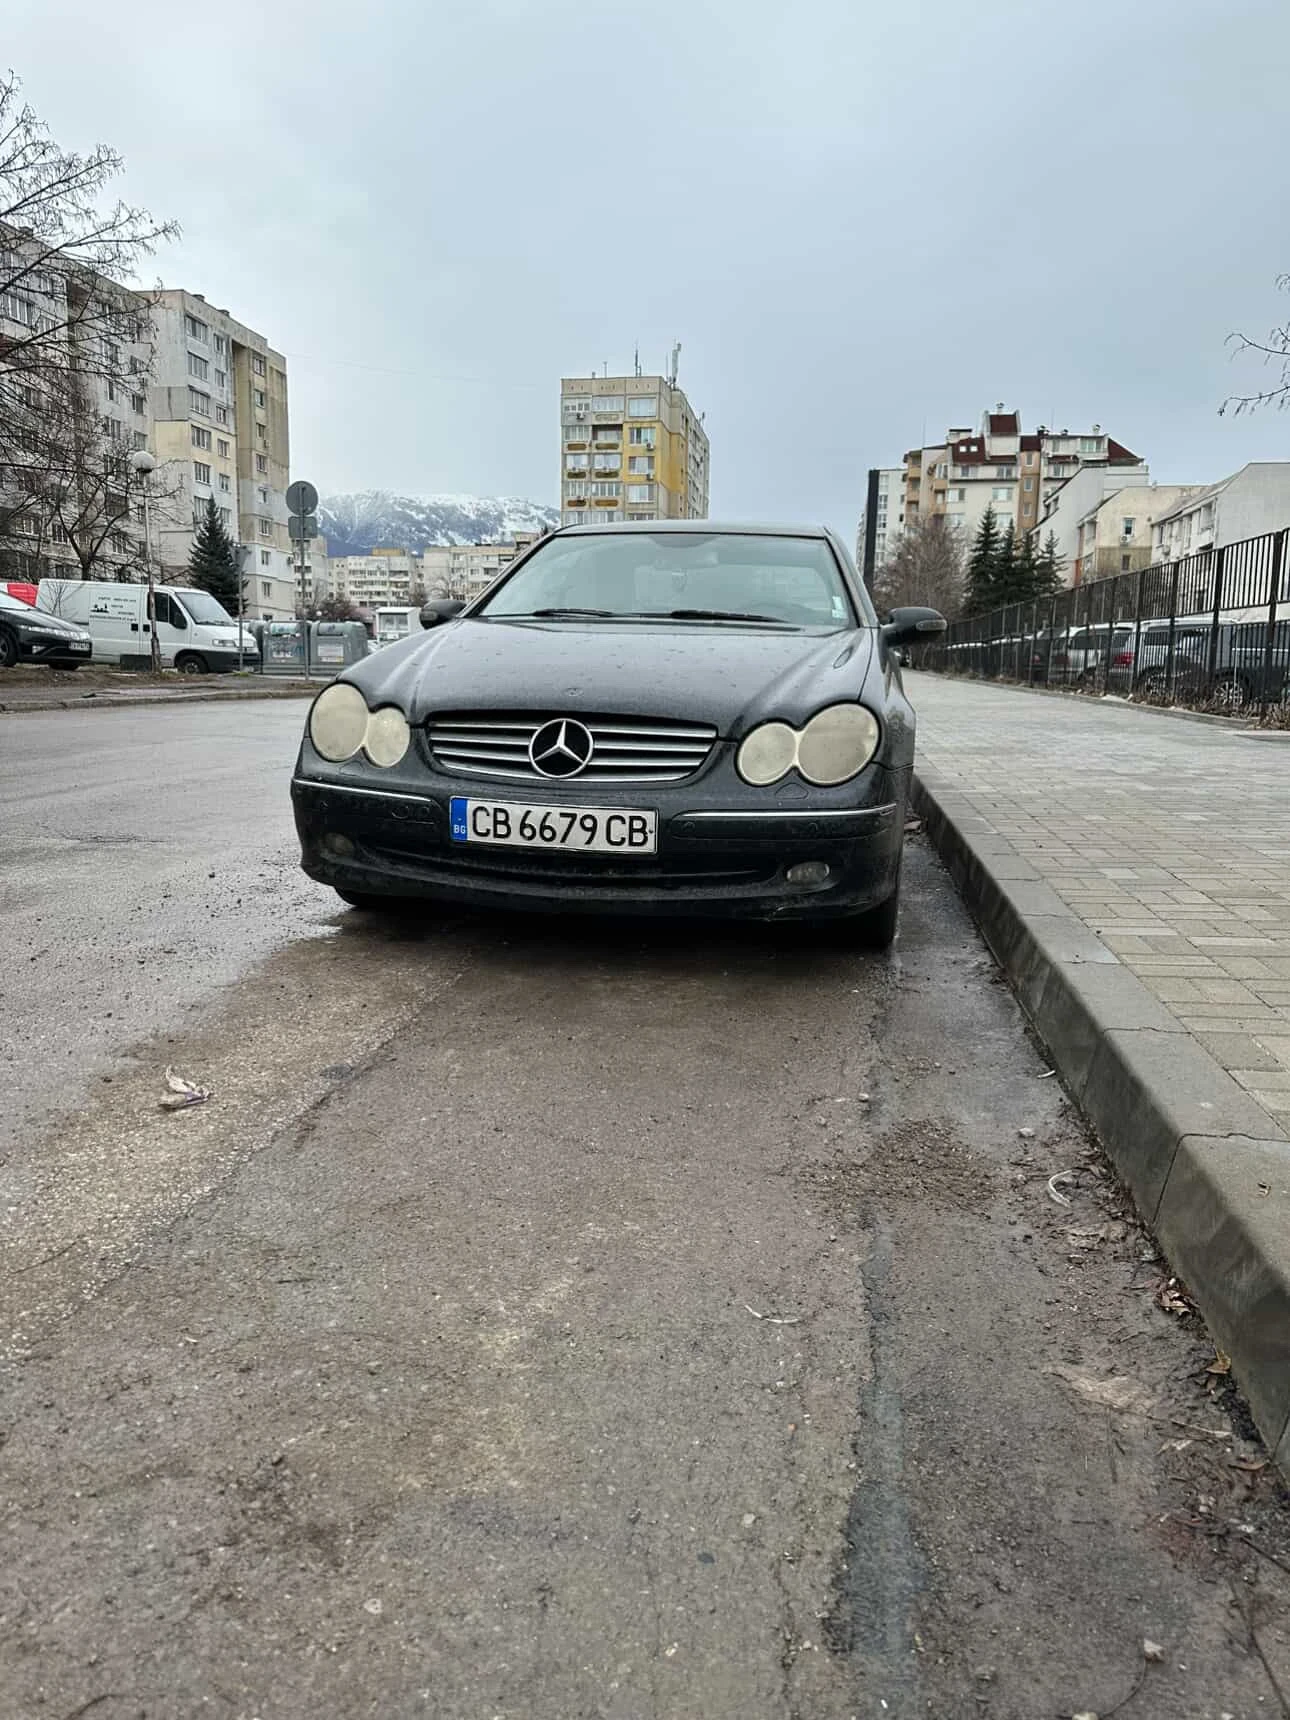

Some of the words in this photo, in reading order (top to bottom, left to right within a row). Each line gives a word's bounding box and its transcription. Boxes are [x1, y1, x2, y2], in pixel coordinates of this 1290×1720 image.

[453, 824, 466, 834] BG
[472, 806, 511, 839] CB
[519, 810, 598, 845] 6679
[606, 815, 649, 847] CB
